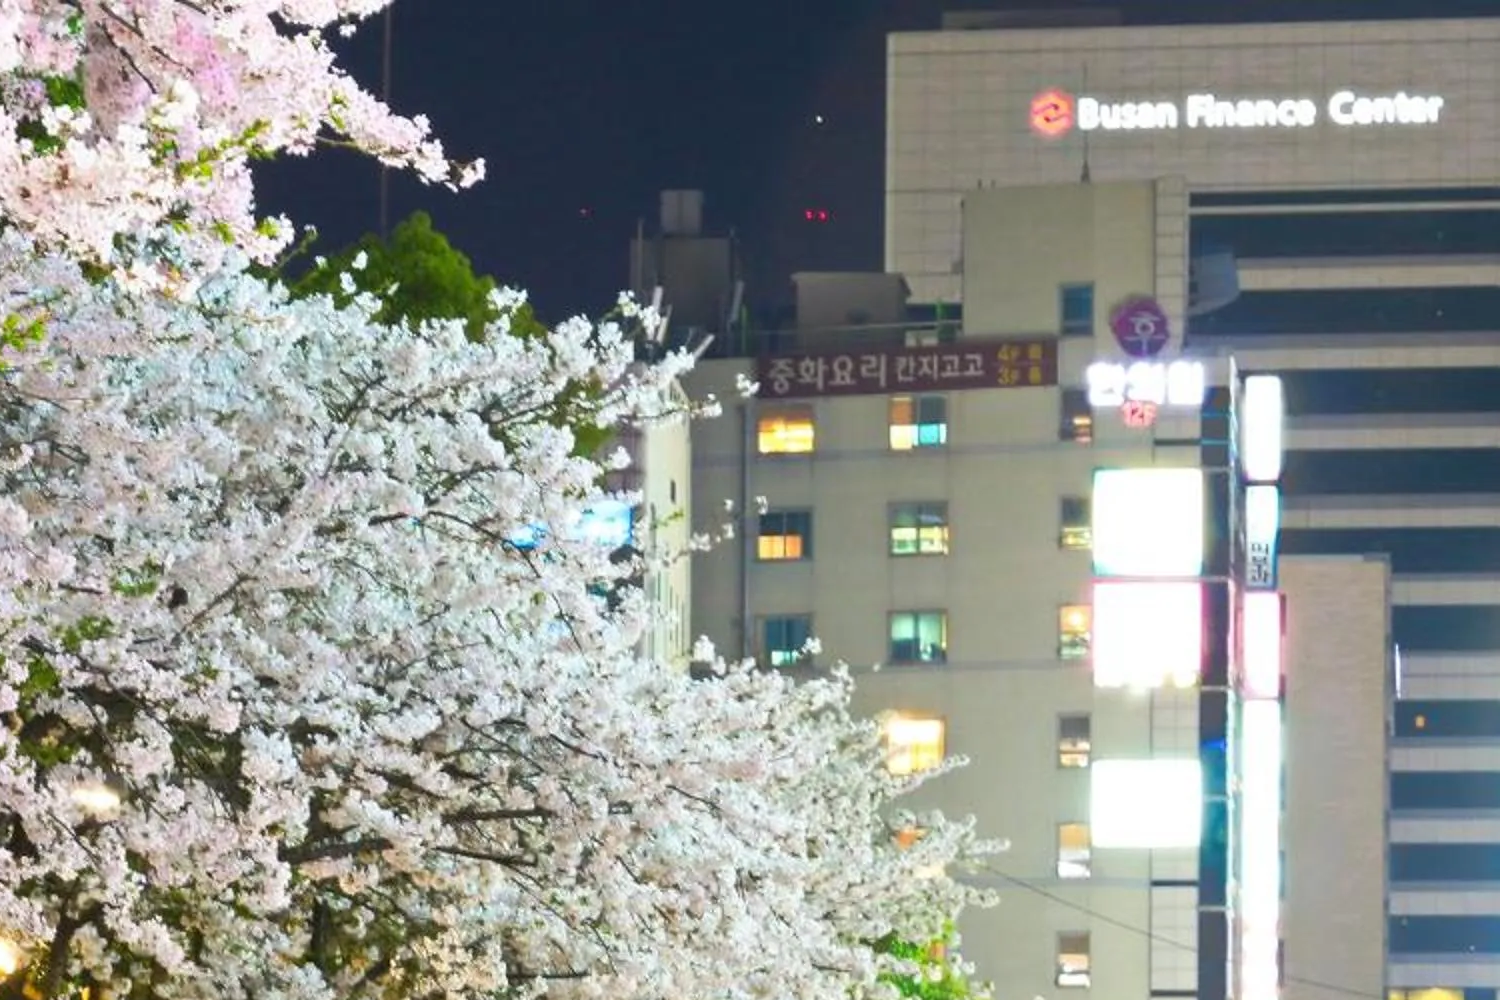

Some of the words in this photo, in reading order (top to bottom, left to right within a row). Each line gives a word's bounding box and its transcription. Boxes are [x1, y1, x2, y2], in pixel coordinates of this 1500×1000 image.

[1077, 97, 1178, 130] Busan
[1186, 93, 1318, 128] Finance
[1327, 90, 1444, 126] Center
[768, 354, 887, 394] 중화요리
